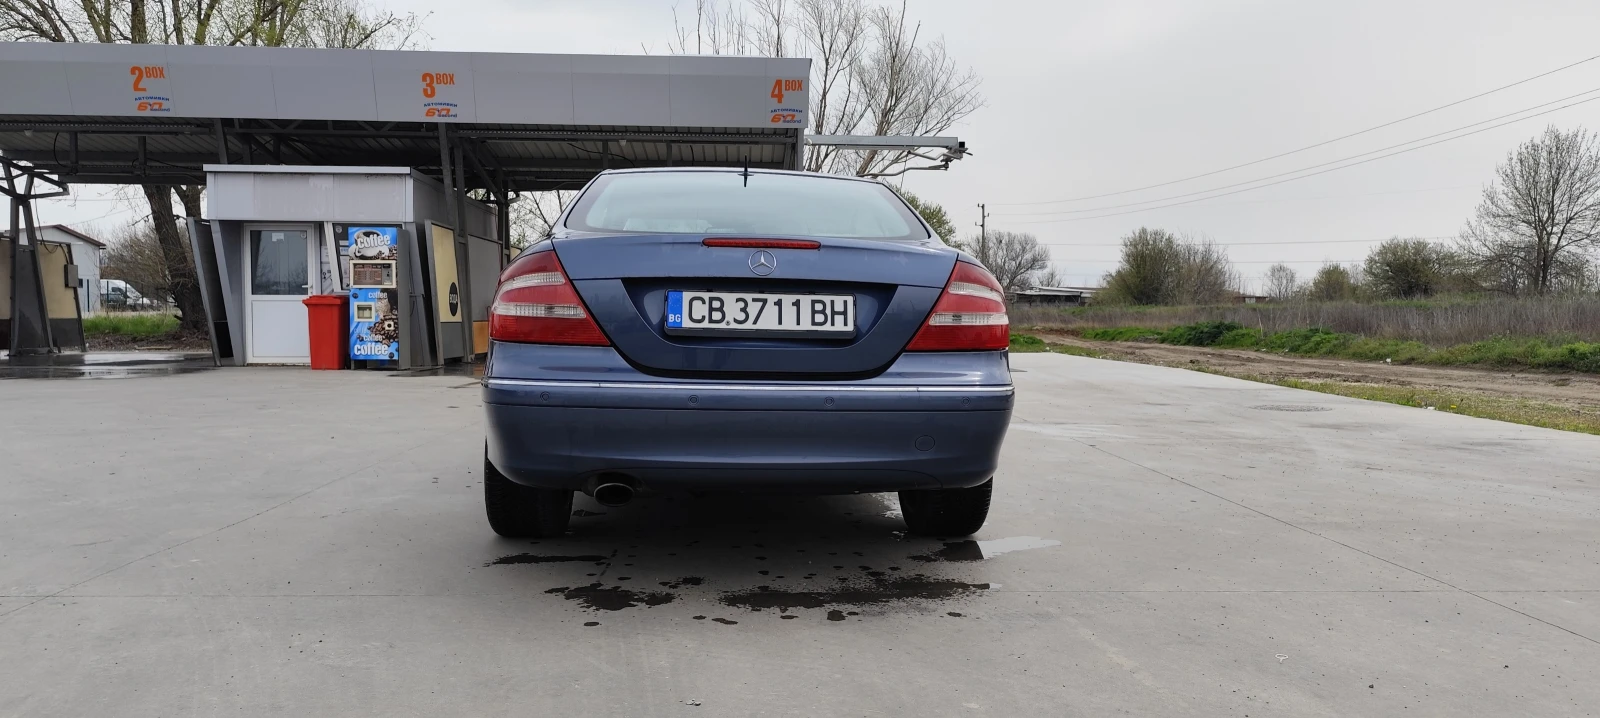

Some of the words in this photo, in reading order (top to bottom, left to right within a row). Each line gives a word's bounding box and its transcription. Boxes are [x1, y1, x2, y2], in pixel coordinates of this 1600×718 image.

[130, 66, 147, 92] 2
[144, 66, 165, 79] BOX
[421, 72, 436, 99] 3
[435, 72, 455, 85] BOX
[770, 79, 784, 104] 4
[784, 79, 803, 91] BOX
[357, 233, 391, 249] coffee
[368, 291, 388, 299] coffee
[668, 313, 682, 323] BG
[354, 342, 389, 356] coffee
